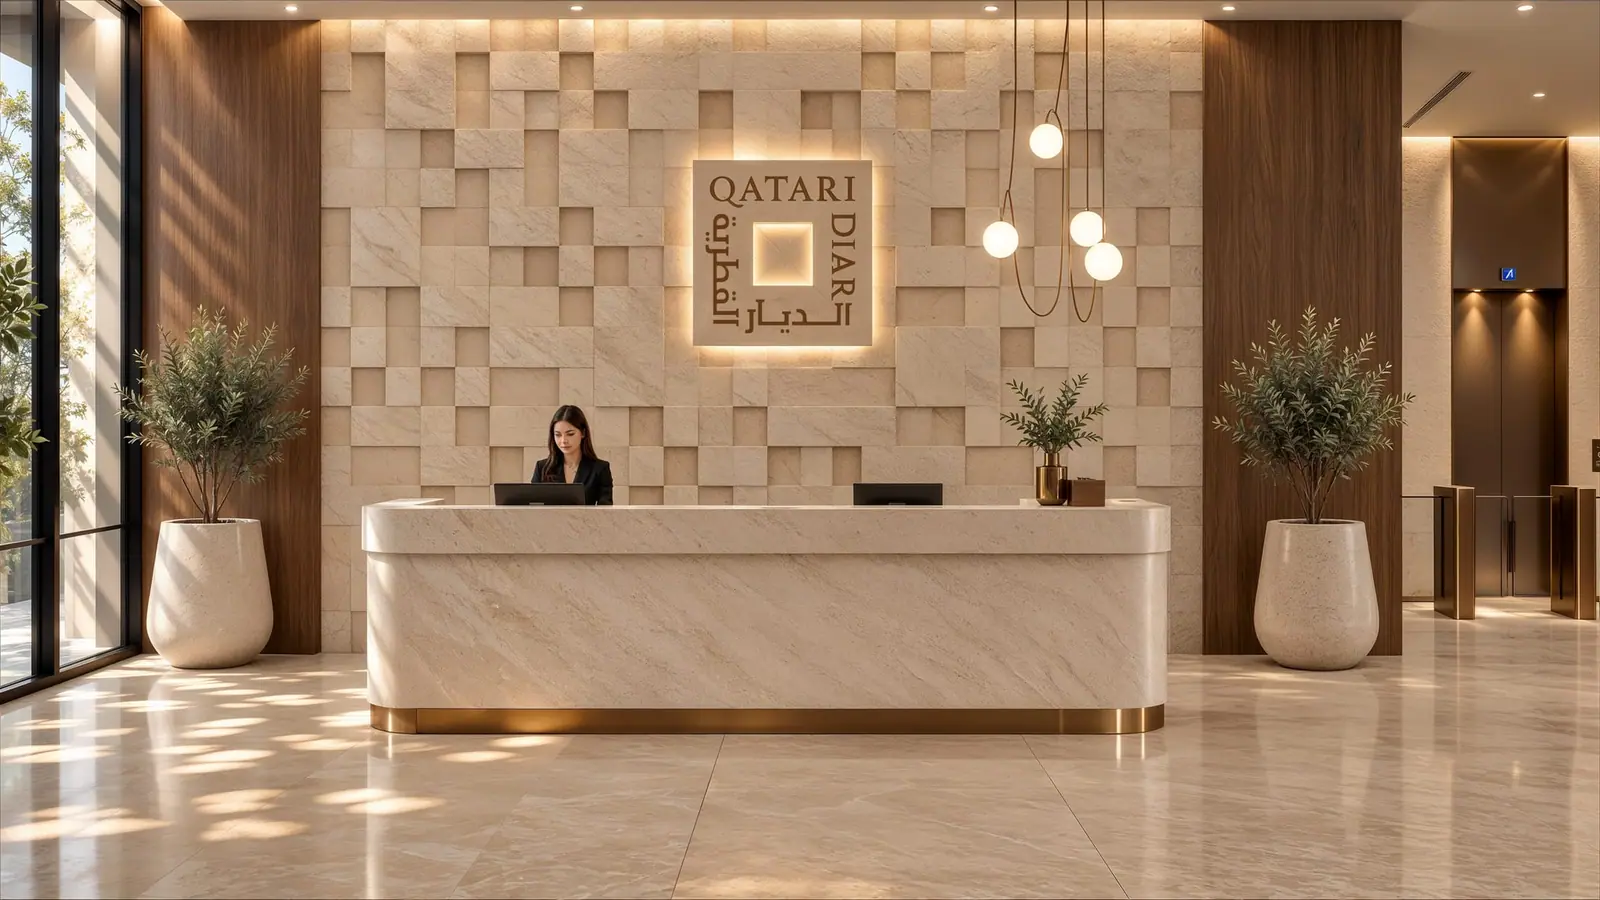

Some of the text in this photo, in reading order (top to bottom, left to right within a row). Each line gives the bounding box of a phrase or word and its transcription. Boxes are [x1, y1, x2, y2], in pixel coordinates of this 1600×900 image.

[709, 176, 856, 208] QATARI
[705, 213, 739, 327] القطرية
[831, 212, 856, 301] DIAR
[745, 299, 853, 334] الديار
